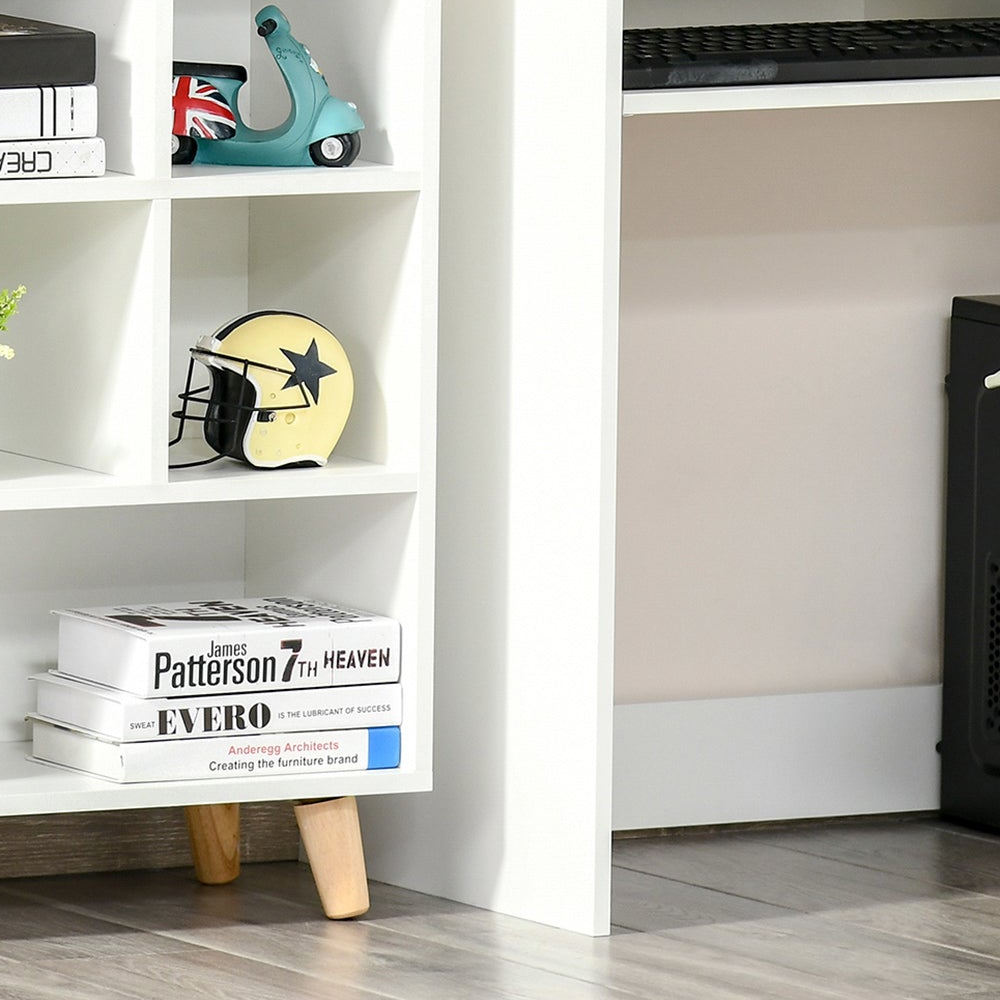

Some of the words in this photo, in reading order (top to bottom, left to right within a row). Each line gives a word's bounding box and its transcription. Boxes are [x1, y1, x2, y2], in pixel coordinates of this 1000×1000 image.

[207, 640, 248, 658] James
[323, 647, 390, 669] HEAVEN
[154, 652, 276, 690] Patterson
[130, 721, 155, 730] SWEAT
[157, 702, 271, 736] EVERO
[287, 711, 301, 719] THE
[302, 708, 343, 718] LUBRICANT
[345, 706, 355, 715] OF
[357, 704, 392, 714] SUCCESS
[228, 745, 281, 756] Anderegg
[284, 741, 340, 753] Architects
[209, 760, 255, 772] Creating
[257, 758, 275, 769] the
[278, 756, 324, 768] furniture
[327, 754, 359, 765] brand
